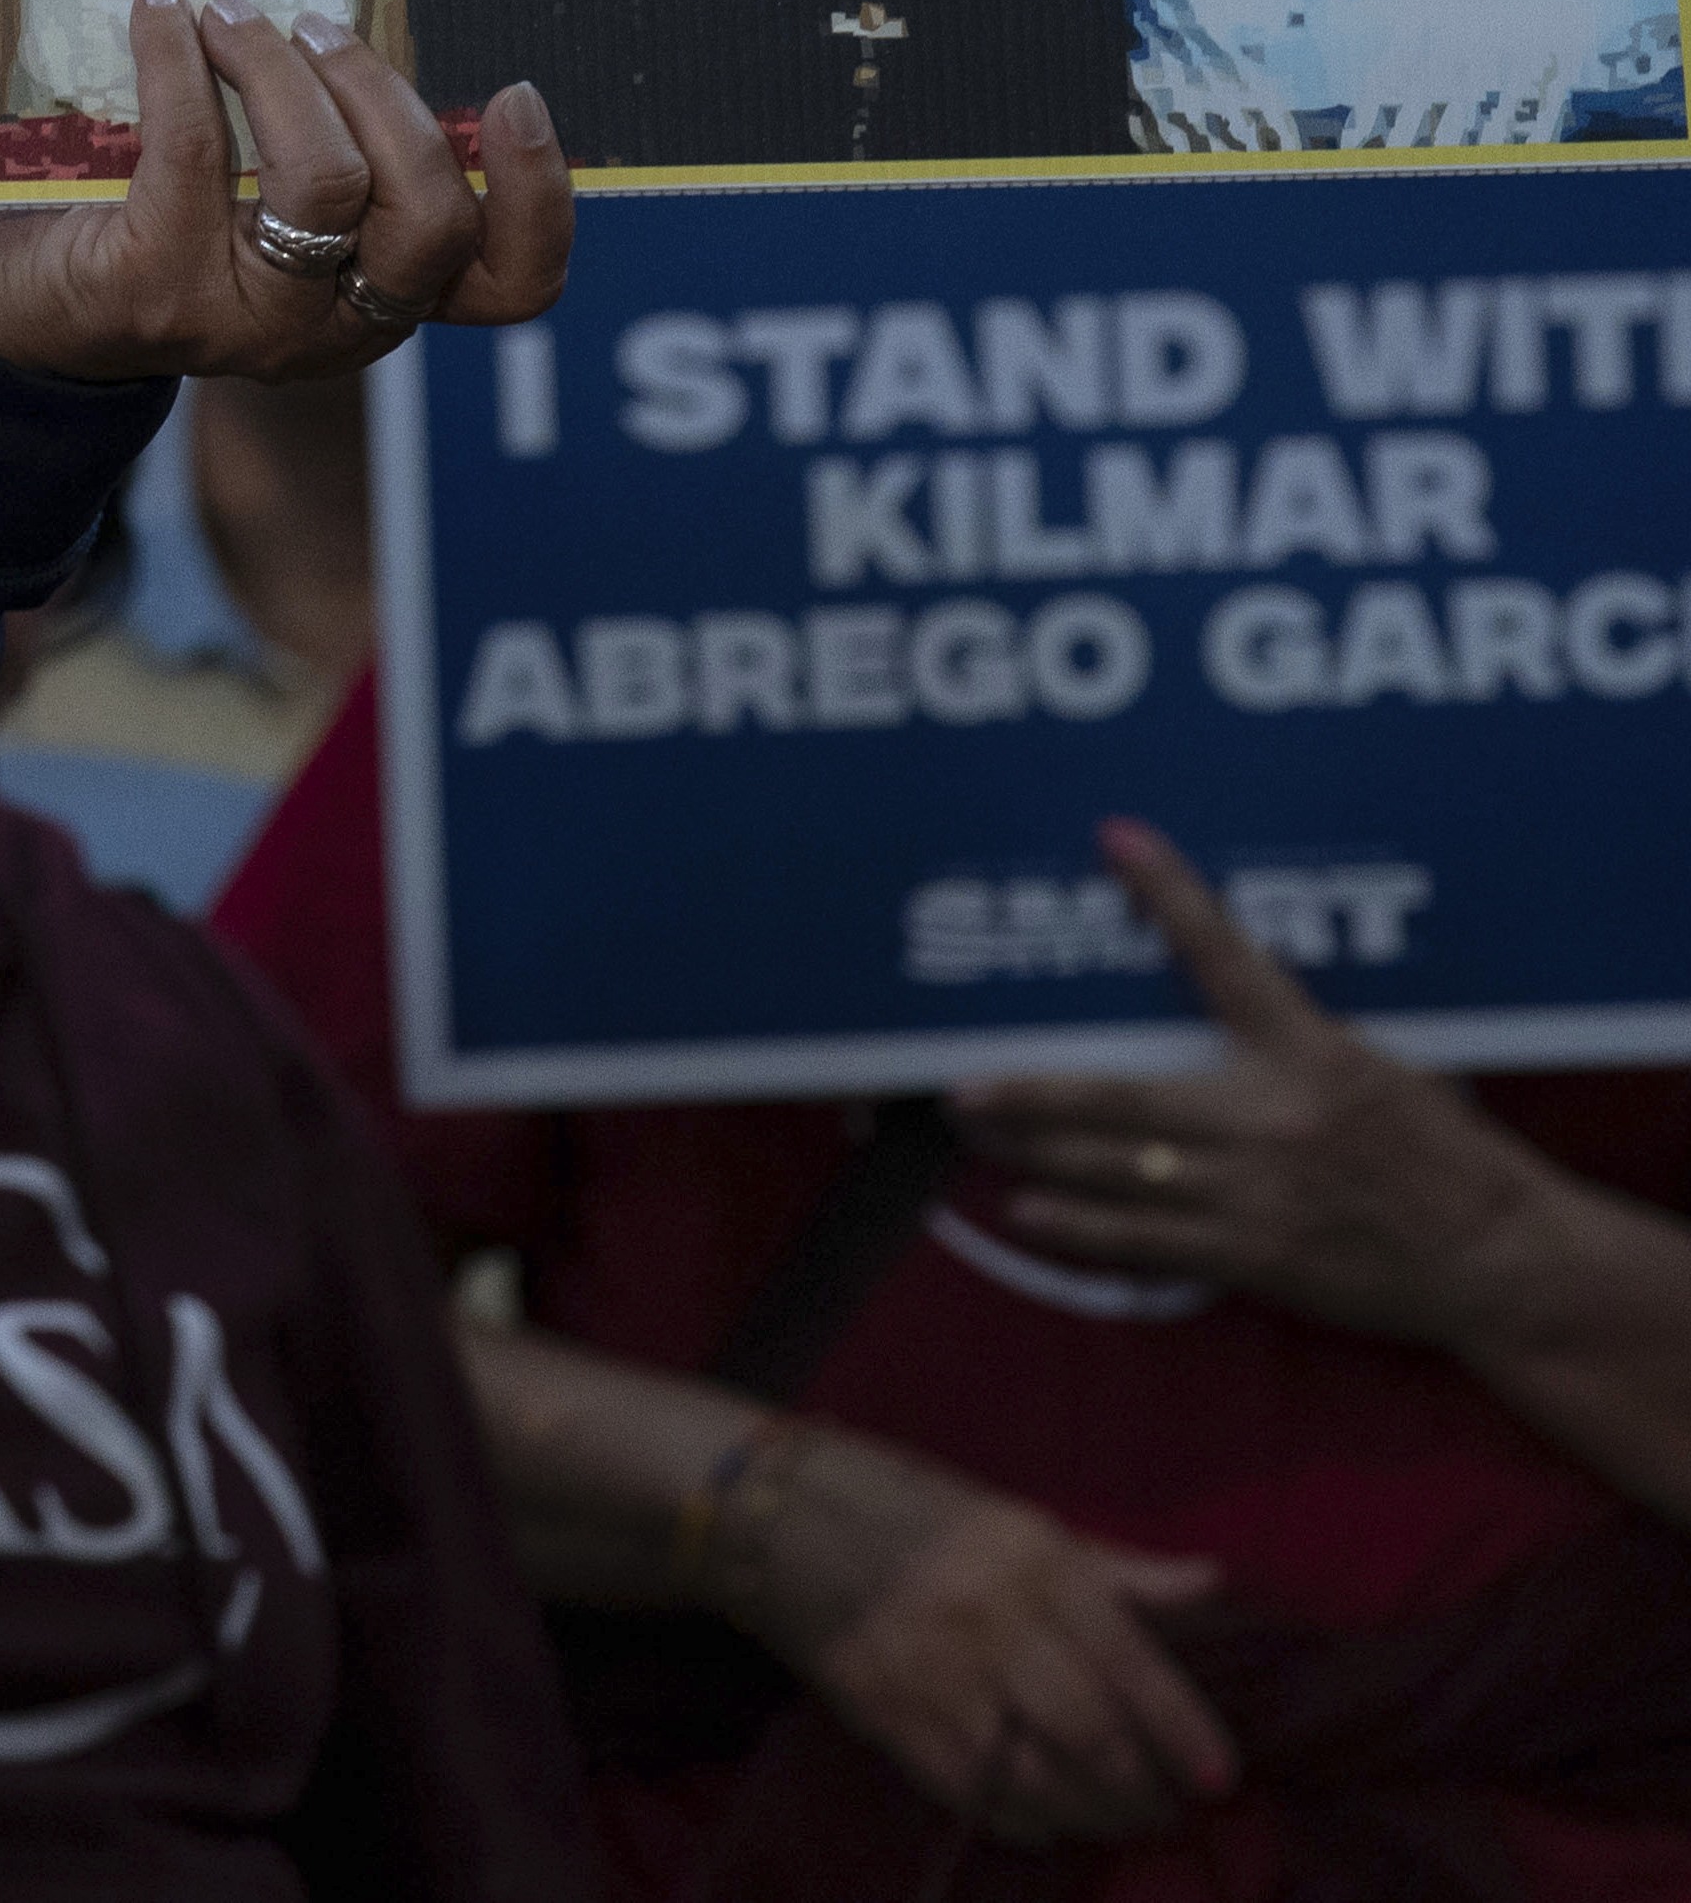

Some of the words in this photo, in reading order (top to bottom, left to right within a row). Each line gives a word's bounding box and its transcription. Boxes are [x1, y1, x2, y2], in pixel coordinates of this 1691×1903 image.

[495, 320, 558, 458] I
[616, 288, 1248, 452] STAND
[803, 430, 1500, 585] KILMAR
[456, 594, 1152, 746] ABREGO
[1204, 570, 1691, 710] GARC
